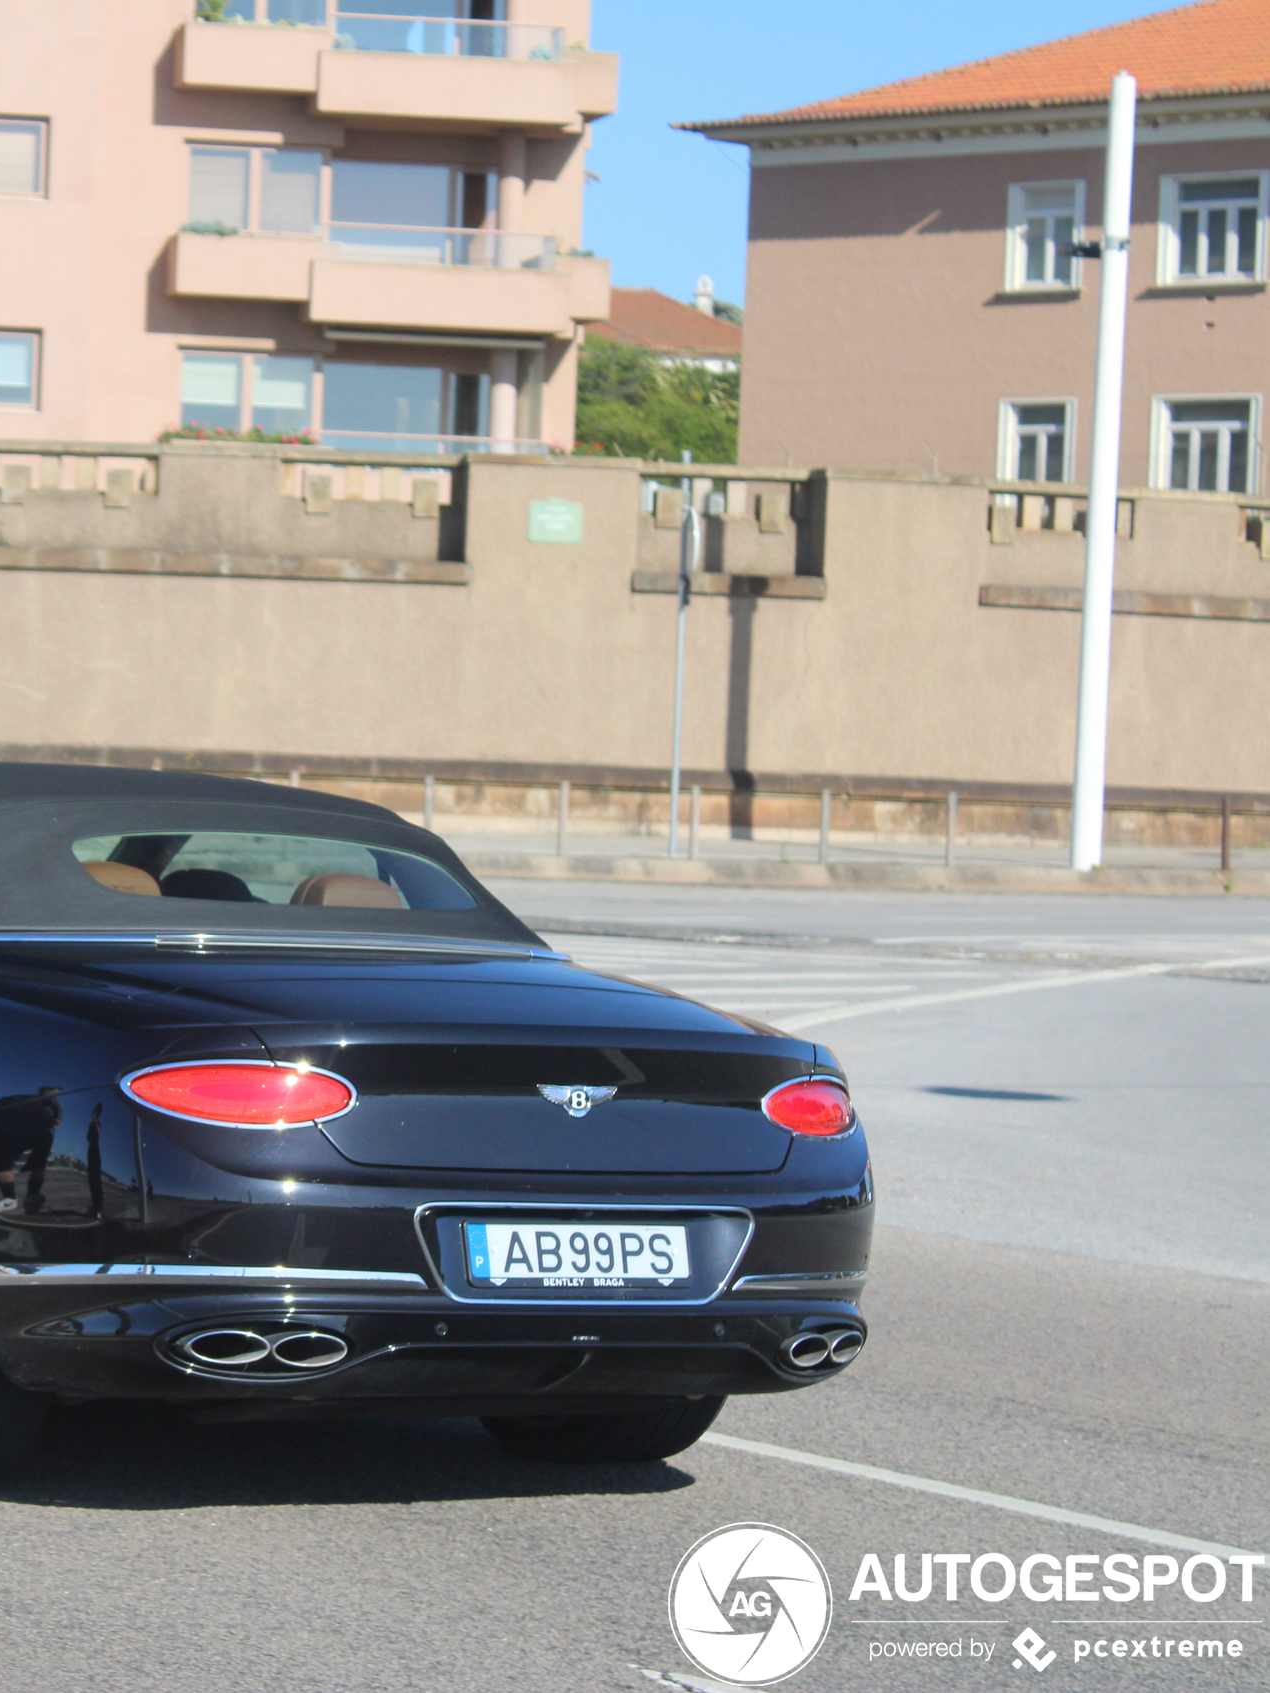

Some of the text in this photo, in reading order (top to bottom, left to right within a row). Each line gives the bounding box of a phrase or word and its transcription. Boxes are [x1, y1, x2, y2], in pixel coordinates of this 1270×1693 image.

[571, 1090, 587, 1110] B
[504, 1230, 673, 1275] AB99PS
[475, 1255, 484, 1268] P
[543, 1278, 625, 1287] BENTLEY BRAGA
